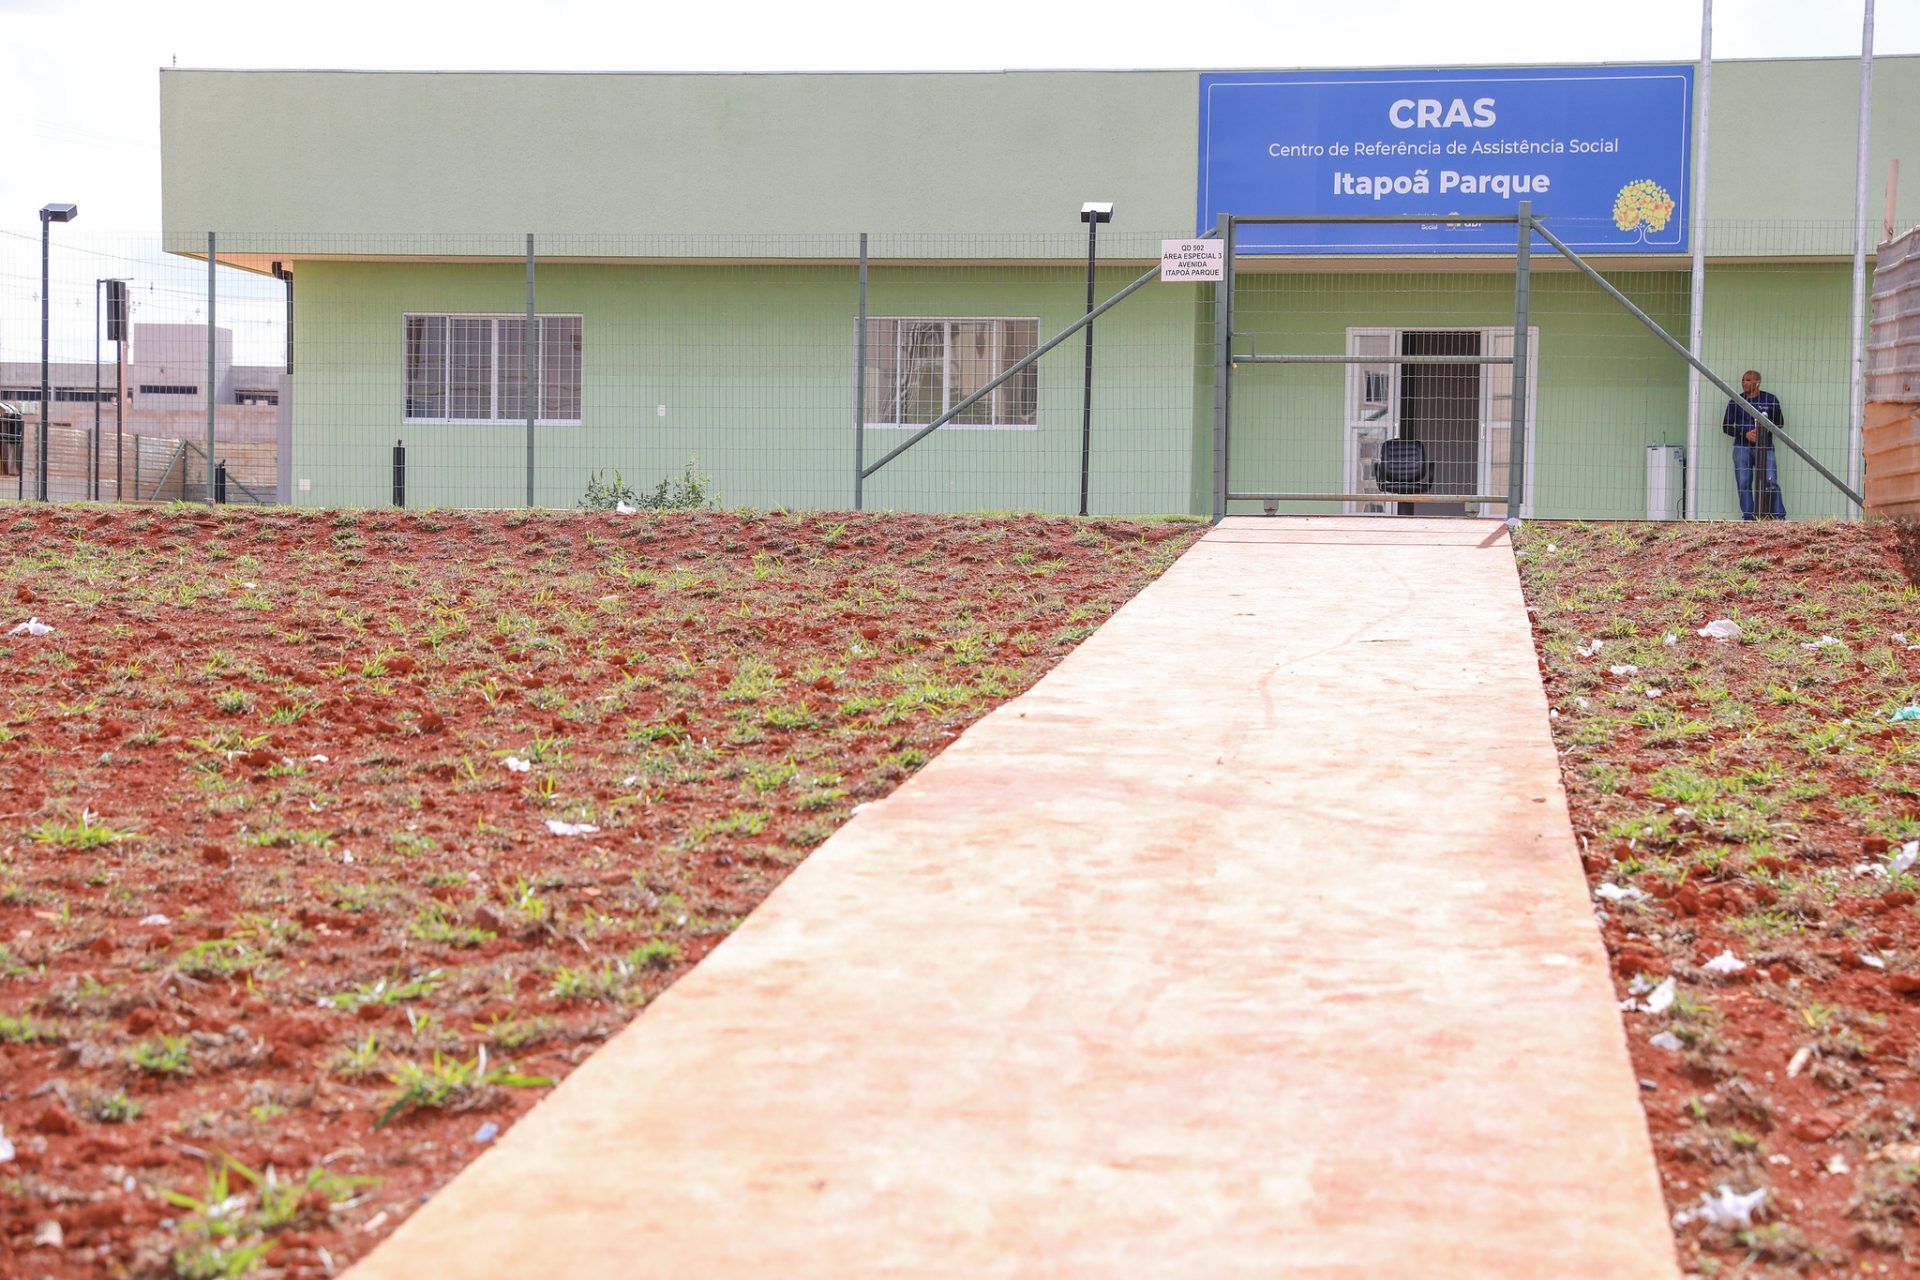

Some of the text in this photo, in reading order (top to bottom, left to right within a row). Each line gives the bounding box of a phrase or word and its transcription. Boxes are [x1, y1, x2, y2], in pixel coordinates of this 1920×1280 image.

[1388, 98, 1497, 129] CRAS
[1268, 138, 1619, 158] Centro de Referência de Assistência Social
[1333, 169, 1551, 201] Itapoã Parque
